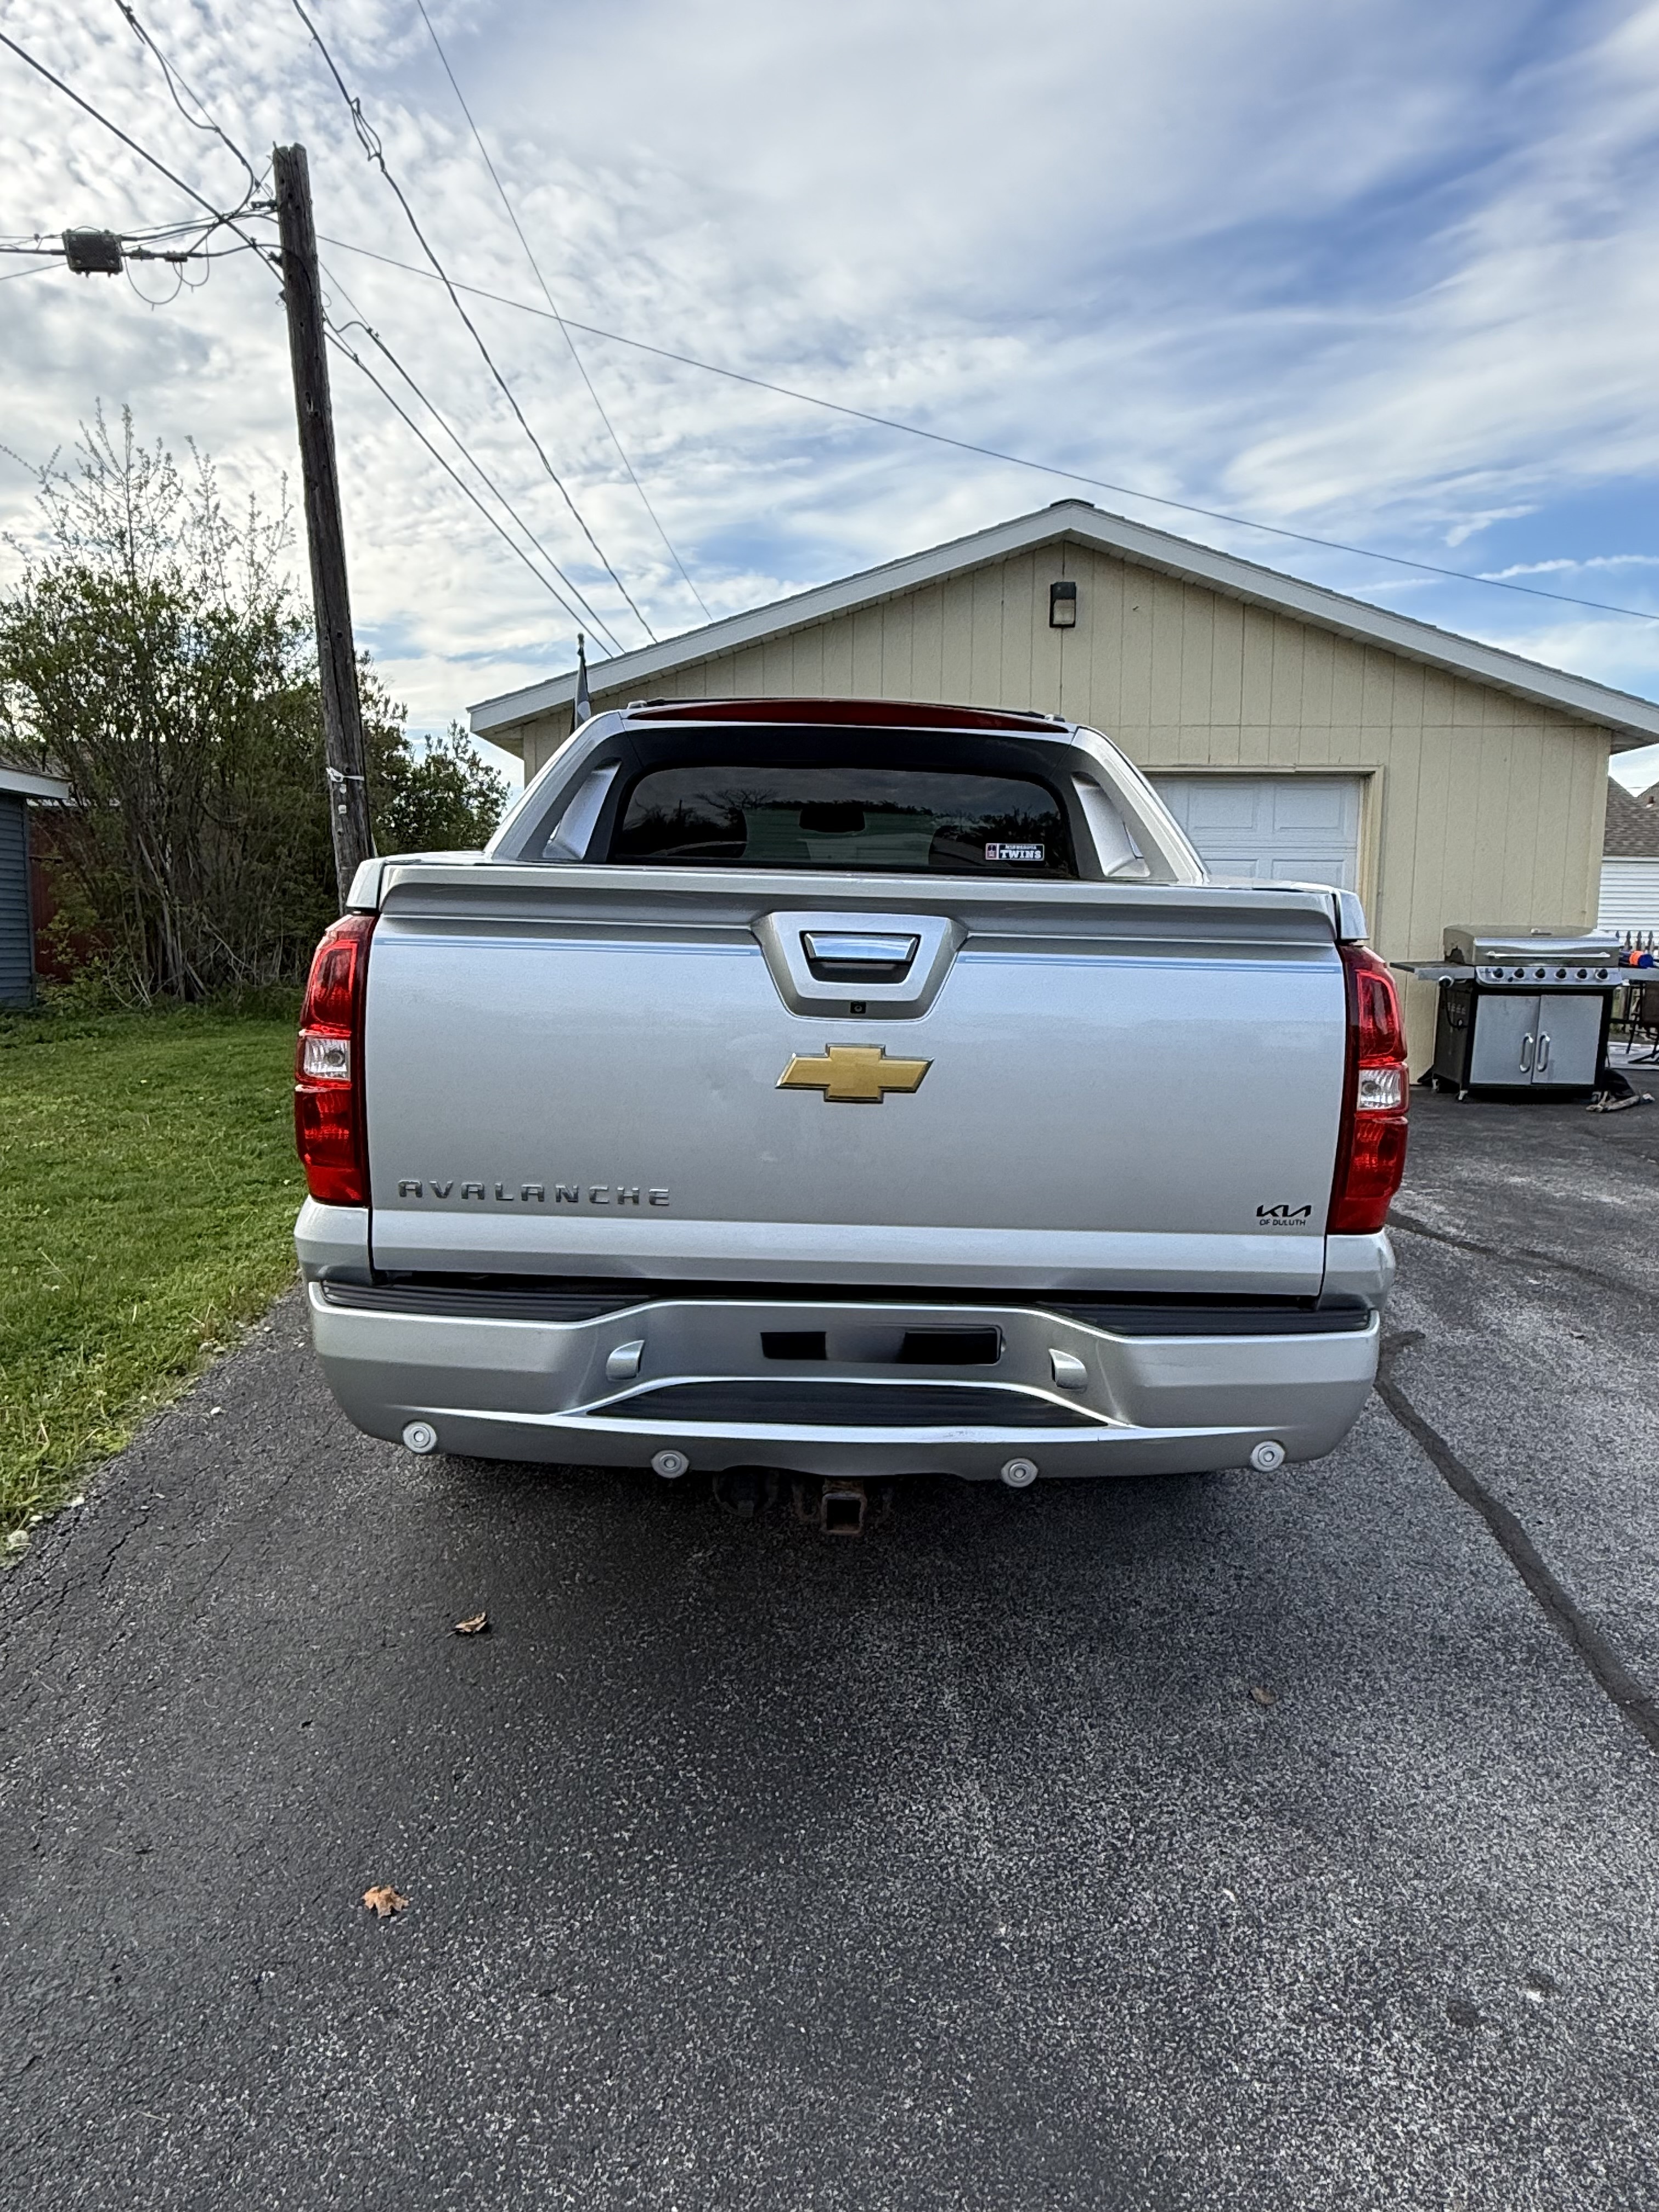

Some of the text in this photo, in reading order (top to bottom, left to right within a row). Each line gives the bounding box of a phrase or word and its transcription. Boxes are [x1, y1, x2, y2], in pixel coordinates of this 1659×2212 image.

[1000, 849, 1041, 859] TWINS
[398, 1180, 670, 1205] AVALANCHE
[1256, 1205, 1312, 1217] KIA
